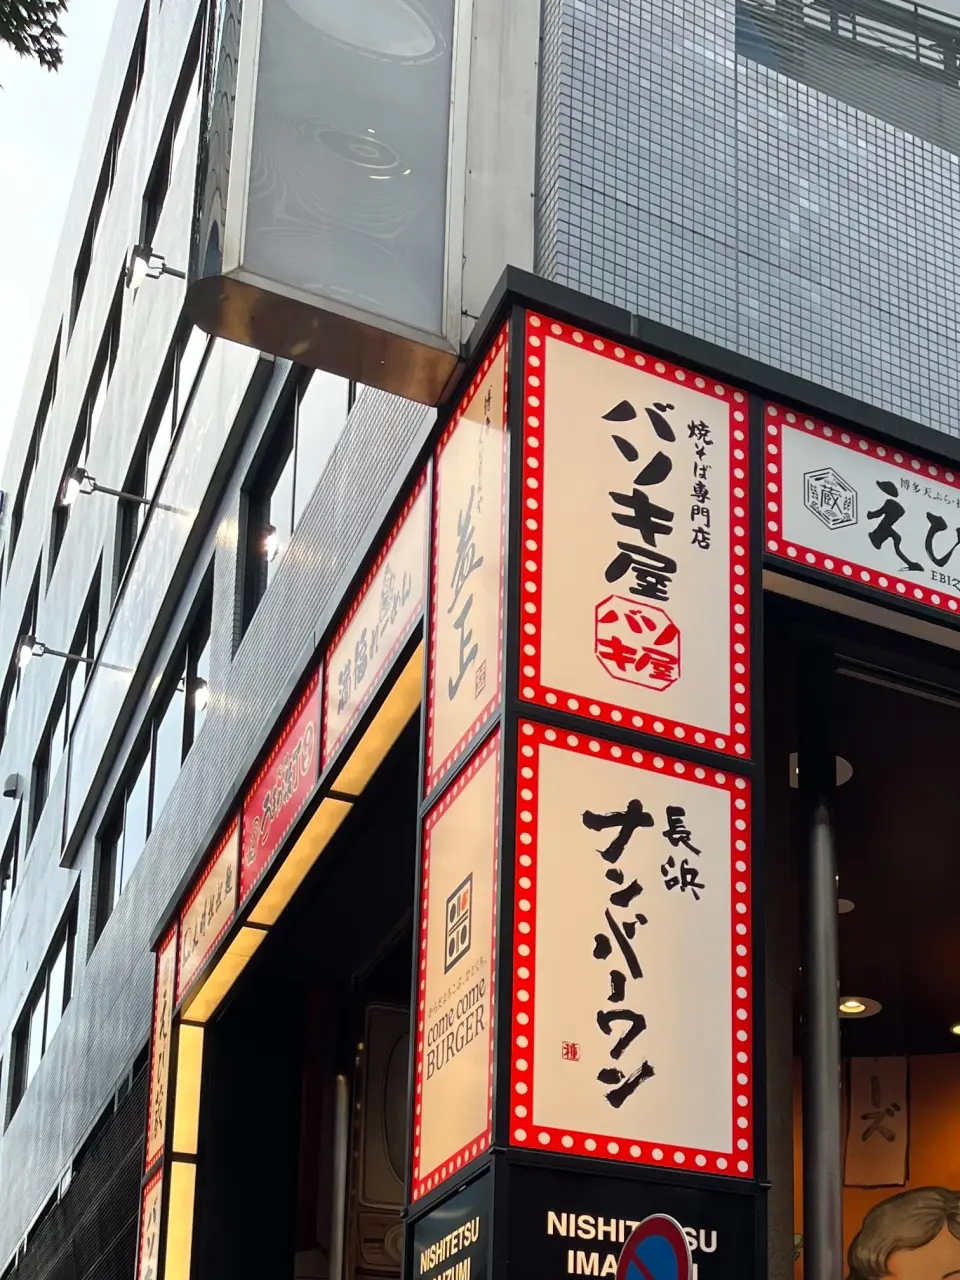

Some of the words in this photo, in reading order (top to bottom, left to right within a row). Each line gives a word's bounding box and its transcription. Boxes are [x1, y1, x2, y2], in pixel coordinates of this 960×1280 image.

[601, 400, 677, 602] バソキ屋
[687, 419, 713, 550] 焼そば専門店
[661, 806, 705, 900] 長浜
[582, 798, 654, 1108] ナンバーワン
[426, 1003, 485, 1081] BURGER
[427, 1008, 455, 1048] come
[456, 978, 487, 1021] come
[419, 1216, 480, 1275] NISHITETSU
[546, 1210, 718, 1253] NISHITSU
